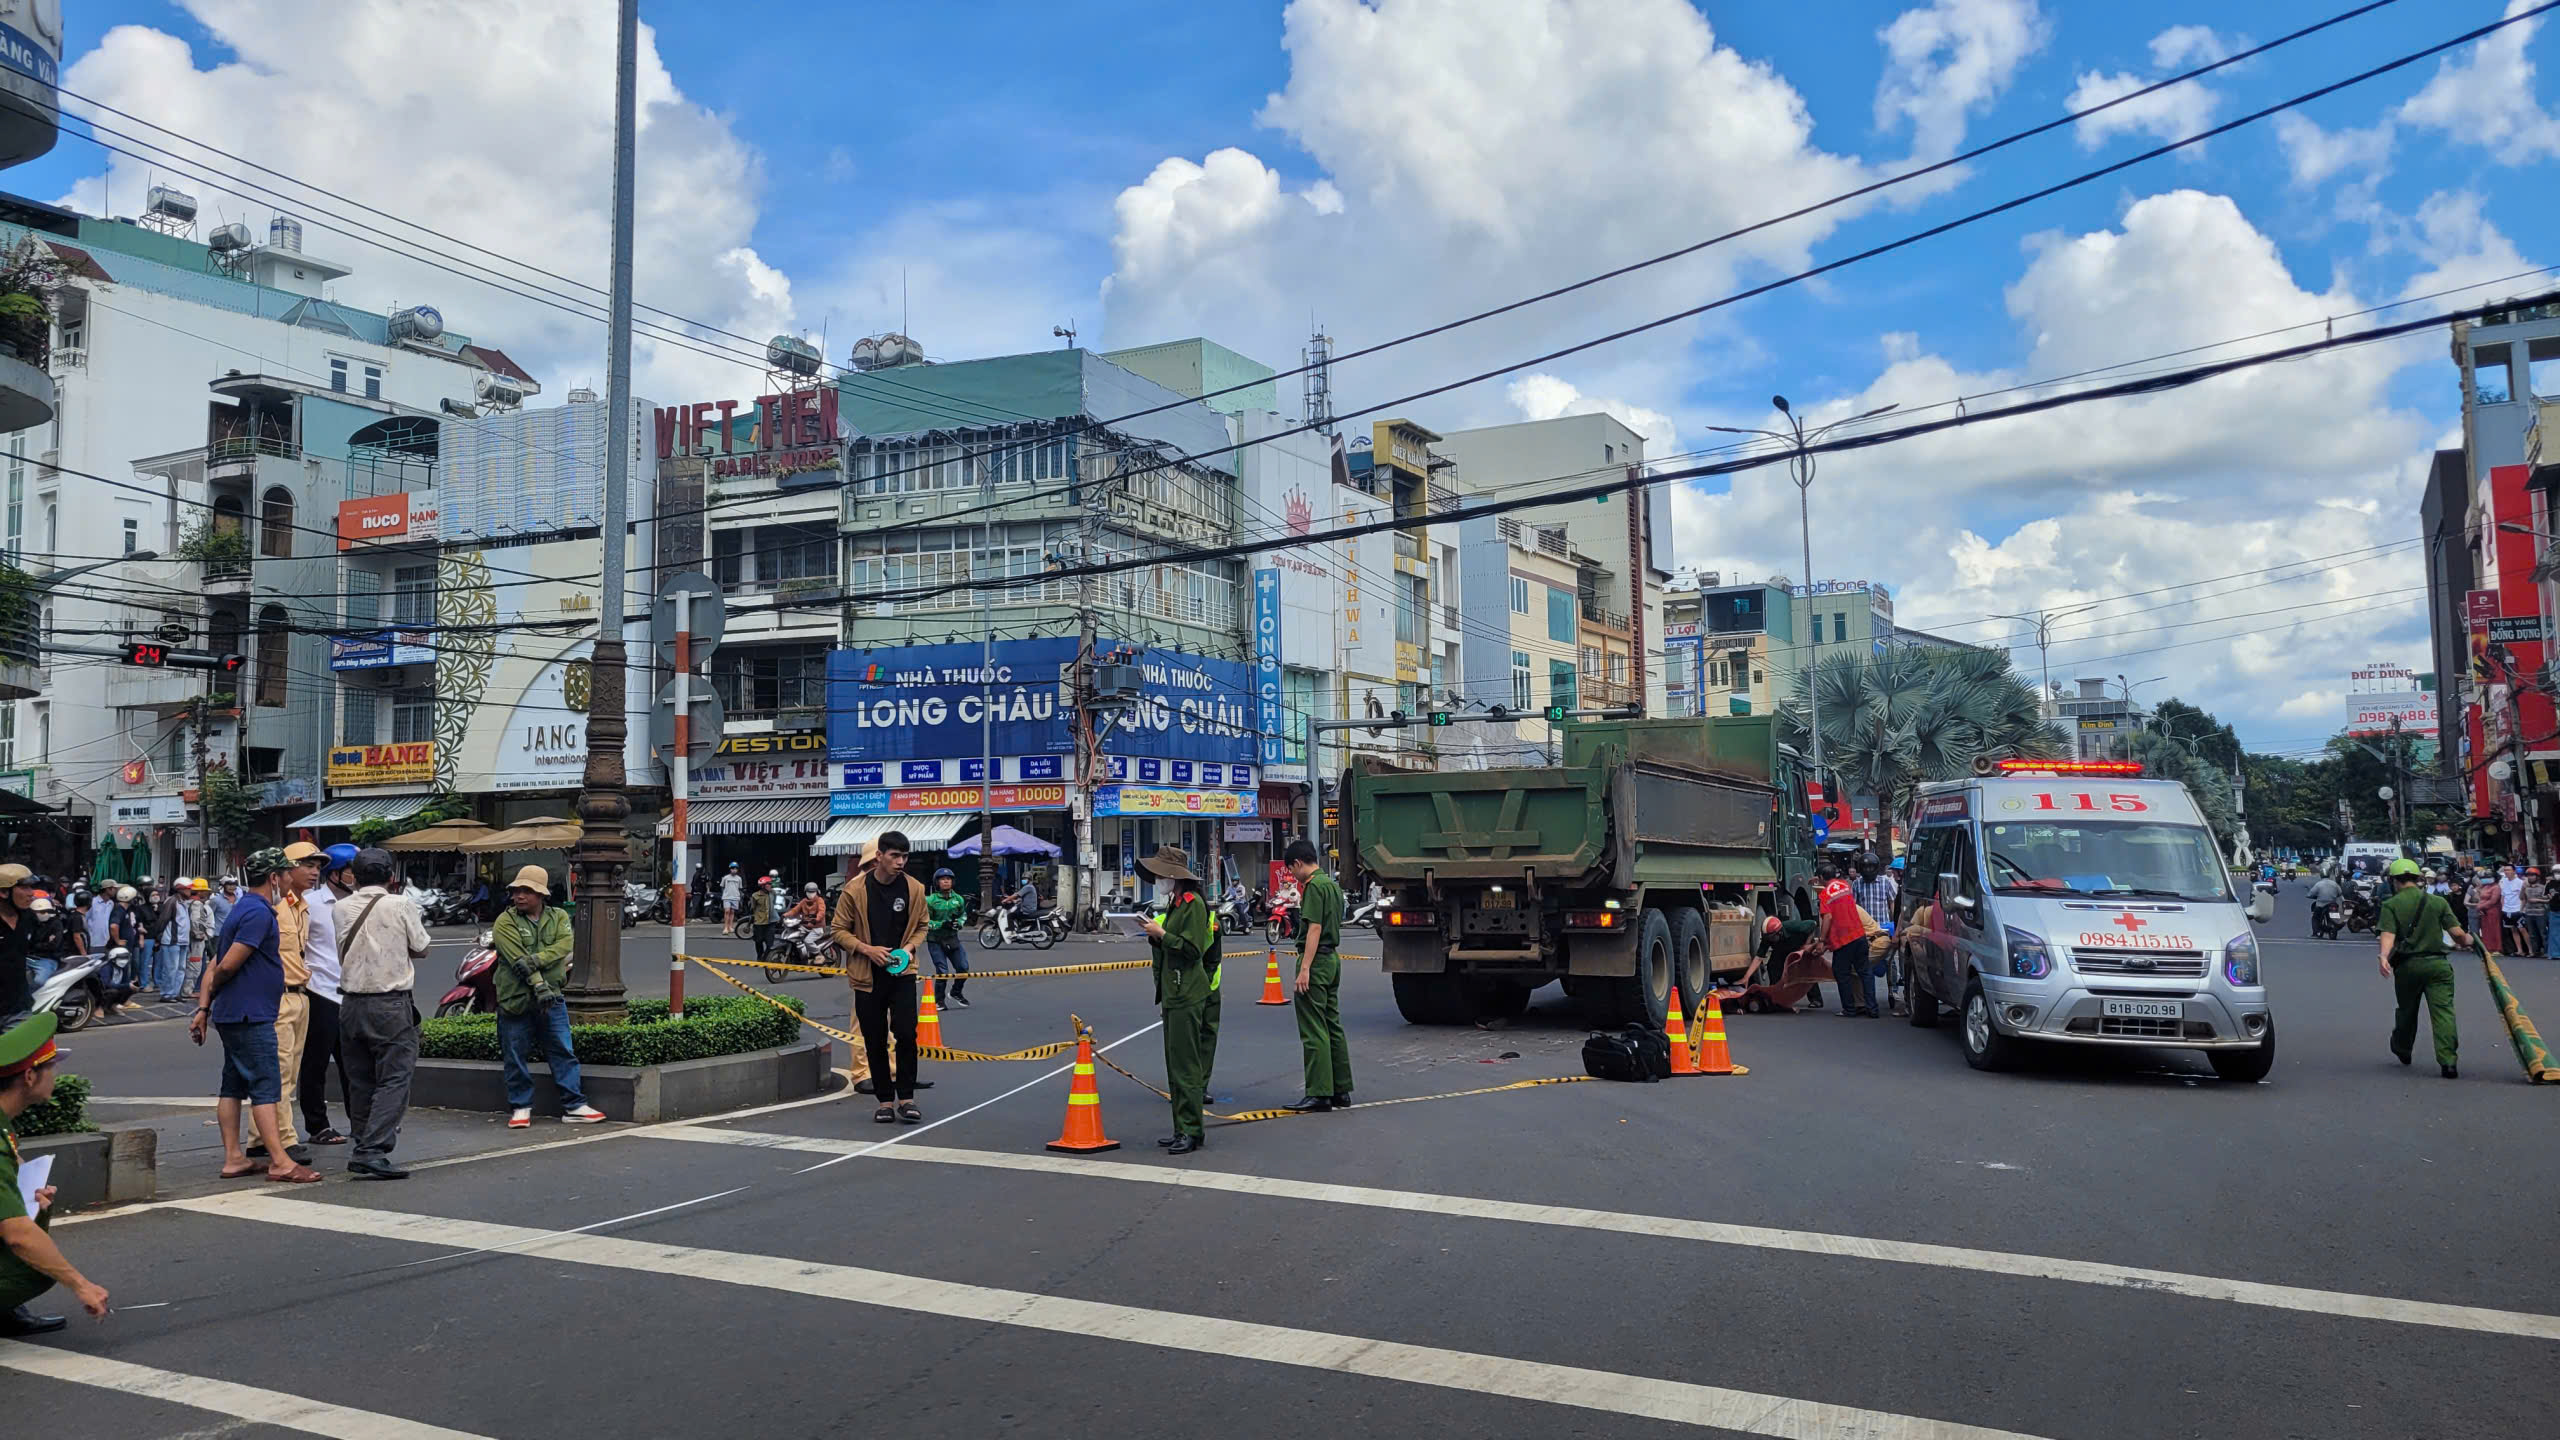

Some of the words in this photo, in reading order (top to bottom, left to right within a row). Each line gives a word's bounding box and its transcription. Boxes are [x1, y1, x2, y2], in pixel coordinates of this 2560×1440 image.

[715, 454, 770, 478] PARIS
[1259, 598, 1276, 672] LONG
[134, 645, 160, 664] 24
[895, 665, 936, 688] NHÀ
[942, 658, 1012, 686] THUỐC
[1142, 661, 1168, 686] NHÀ
[1171, 664, 1213, 692] THUỐC
[857, 697, 948, 728] LONG
[958, 685, 1053, 724] CHÂU
[1103, 694, 1170, 731] NG
[1180, 694, 1243, 738] CHÂU
[1551, 707, 1563, 720] 19
[1261, 682, 1277, 760] CHÂU
[1434, 713, 1446, 725] 19
[523, 724, 577, 752] JANG
[364, 744, 429, 769] HẠNH
[535, 753, 588, 766] Internationa
[833, 792, 851, 800] 100%
[852, 791, 868, 799] TÍCH
[869, 790, 886, 799] ĐIỂM
[921, 790, 980, 806] 50.000Đ
[1017, 787, 1063, 802] 1.000Đ
[2031, 792, 2149, 813] 115
[833, 802, 851, 810] NHẬN
[865, 800, 886, 809] QUYỀN
[2080, 932, 2193, 949] 0984.115.115
[2109, 1003, 2176, 1016] 81B-020.98
